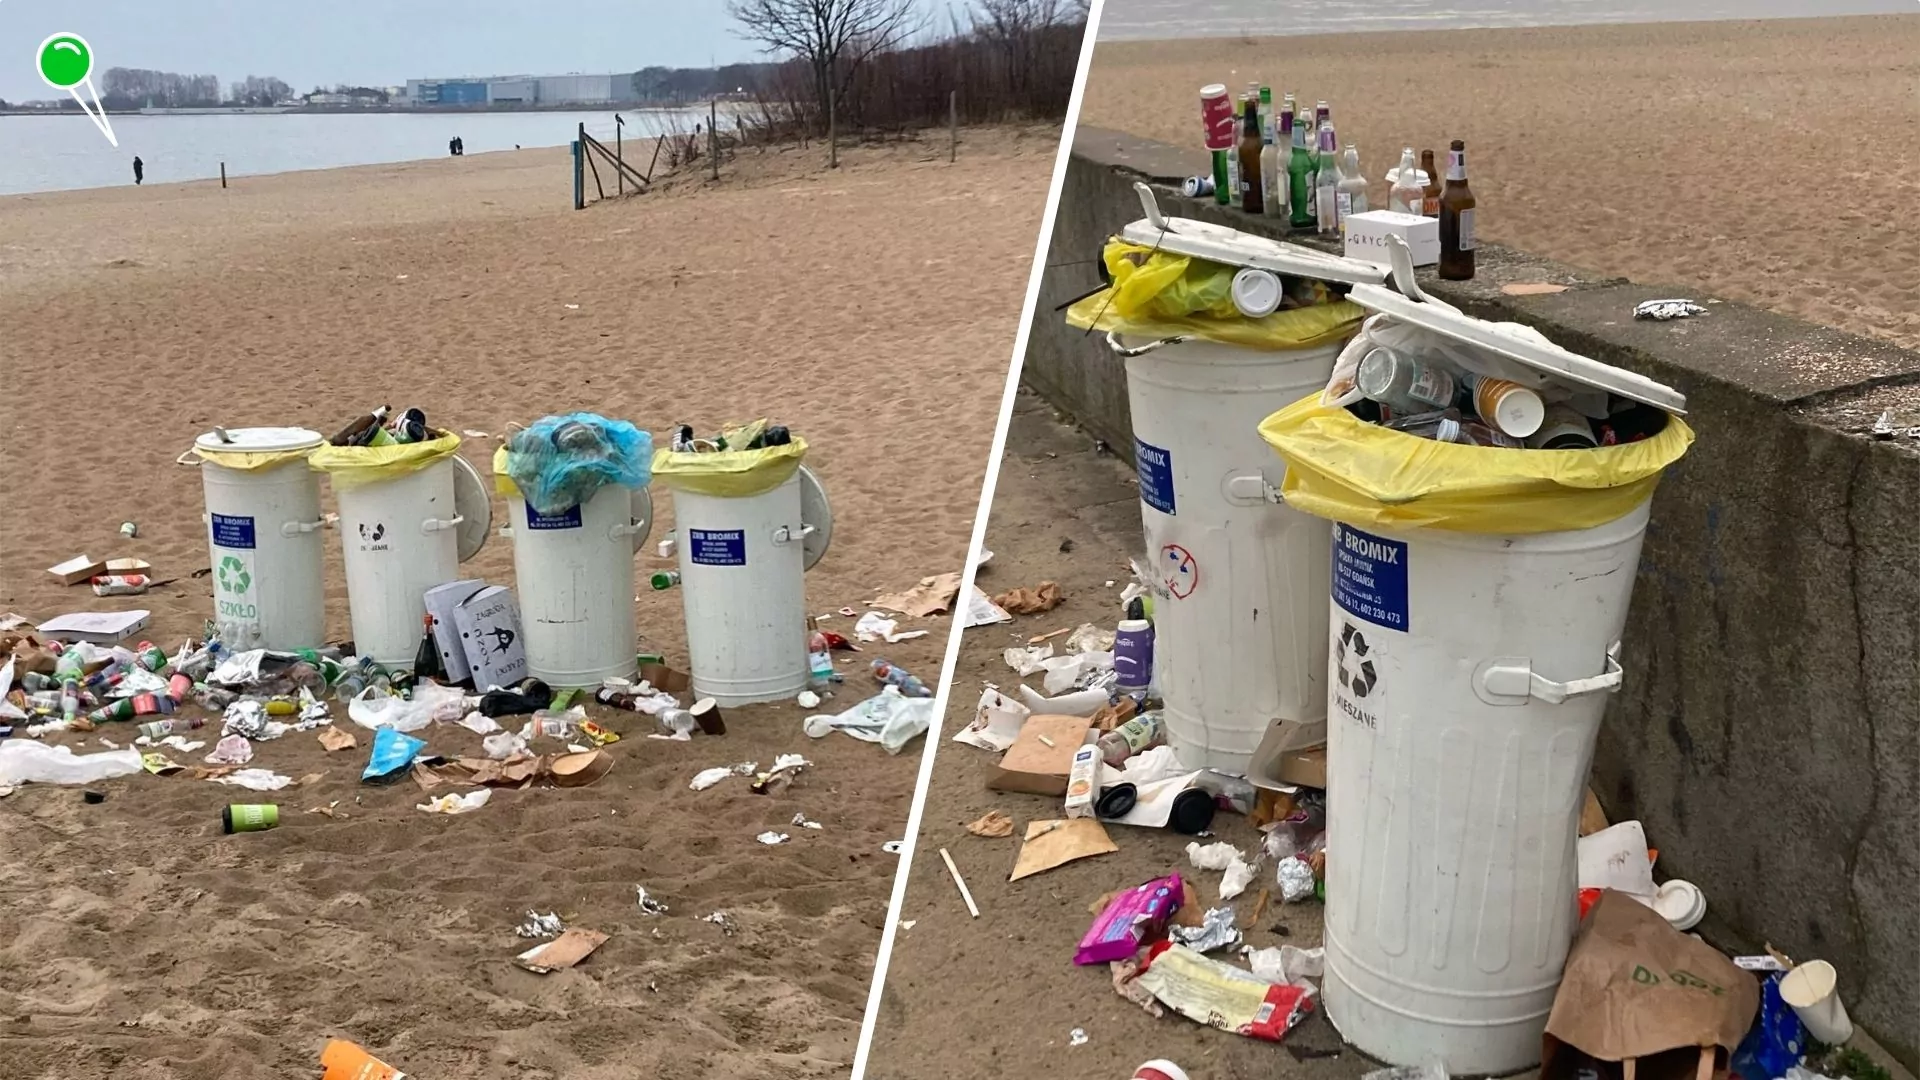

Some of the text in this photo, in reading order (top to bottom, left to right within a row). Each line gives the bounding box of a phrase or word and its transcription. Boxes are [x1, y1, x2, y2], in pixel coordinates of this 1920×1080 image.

[1352, 233, 1388, 248] GRYC
[707, 532, 739, 541] BROMIX
[1345, 531, 1398, 565] BROMIX
[1351, 571, 1375, 589] GDAŃSK
[219, 599, 256, 618] SZKŁO
[1360, 604, 1372, 616] 602
[1373, 607, 1385, 620] 230
[1387, 611, 1401, 624] 473
